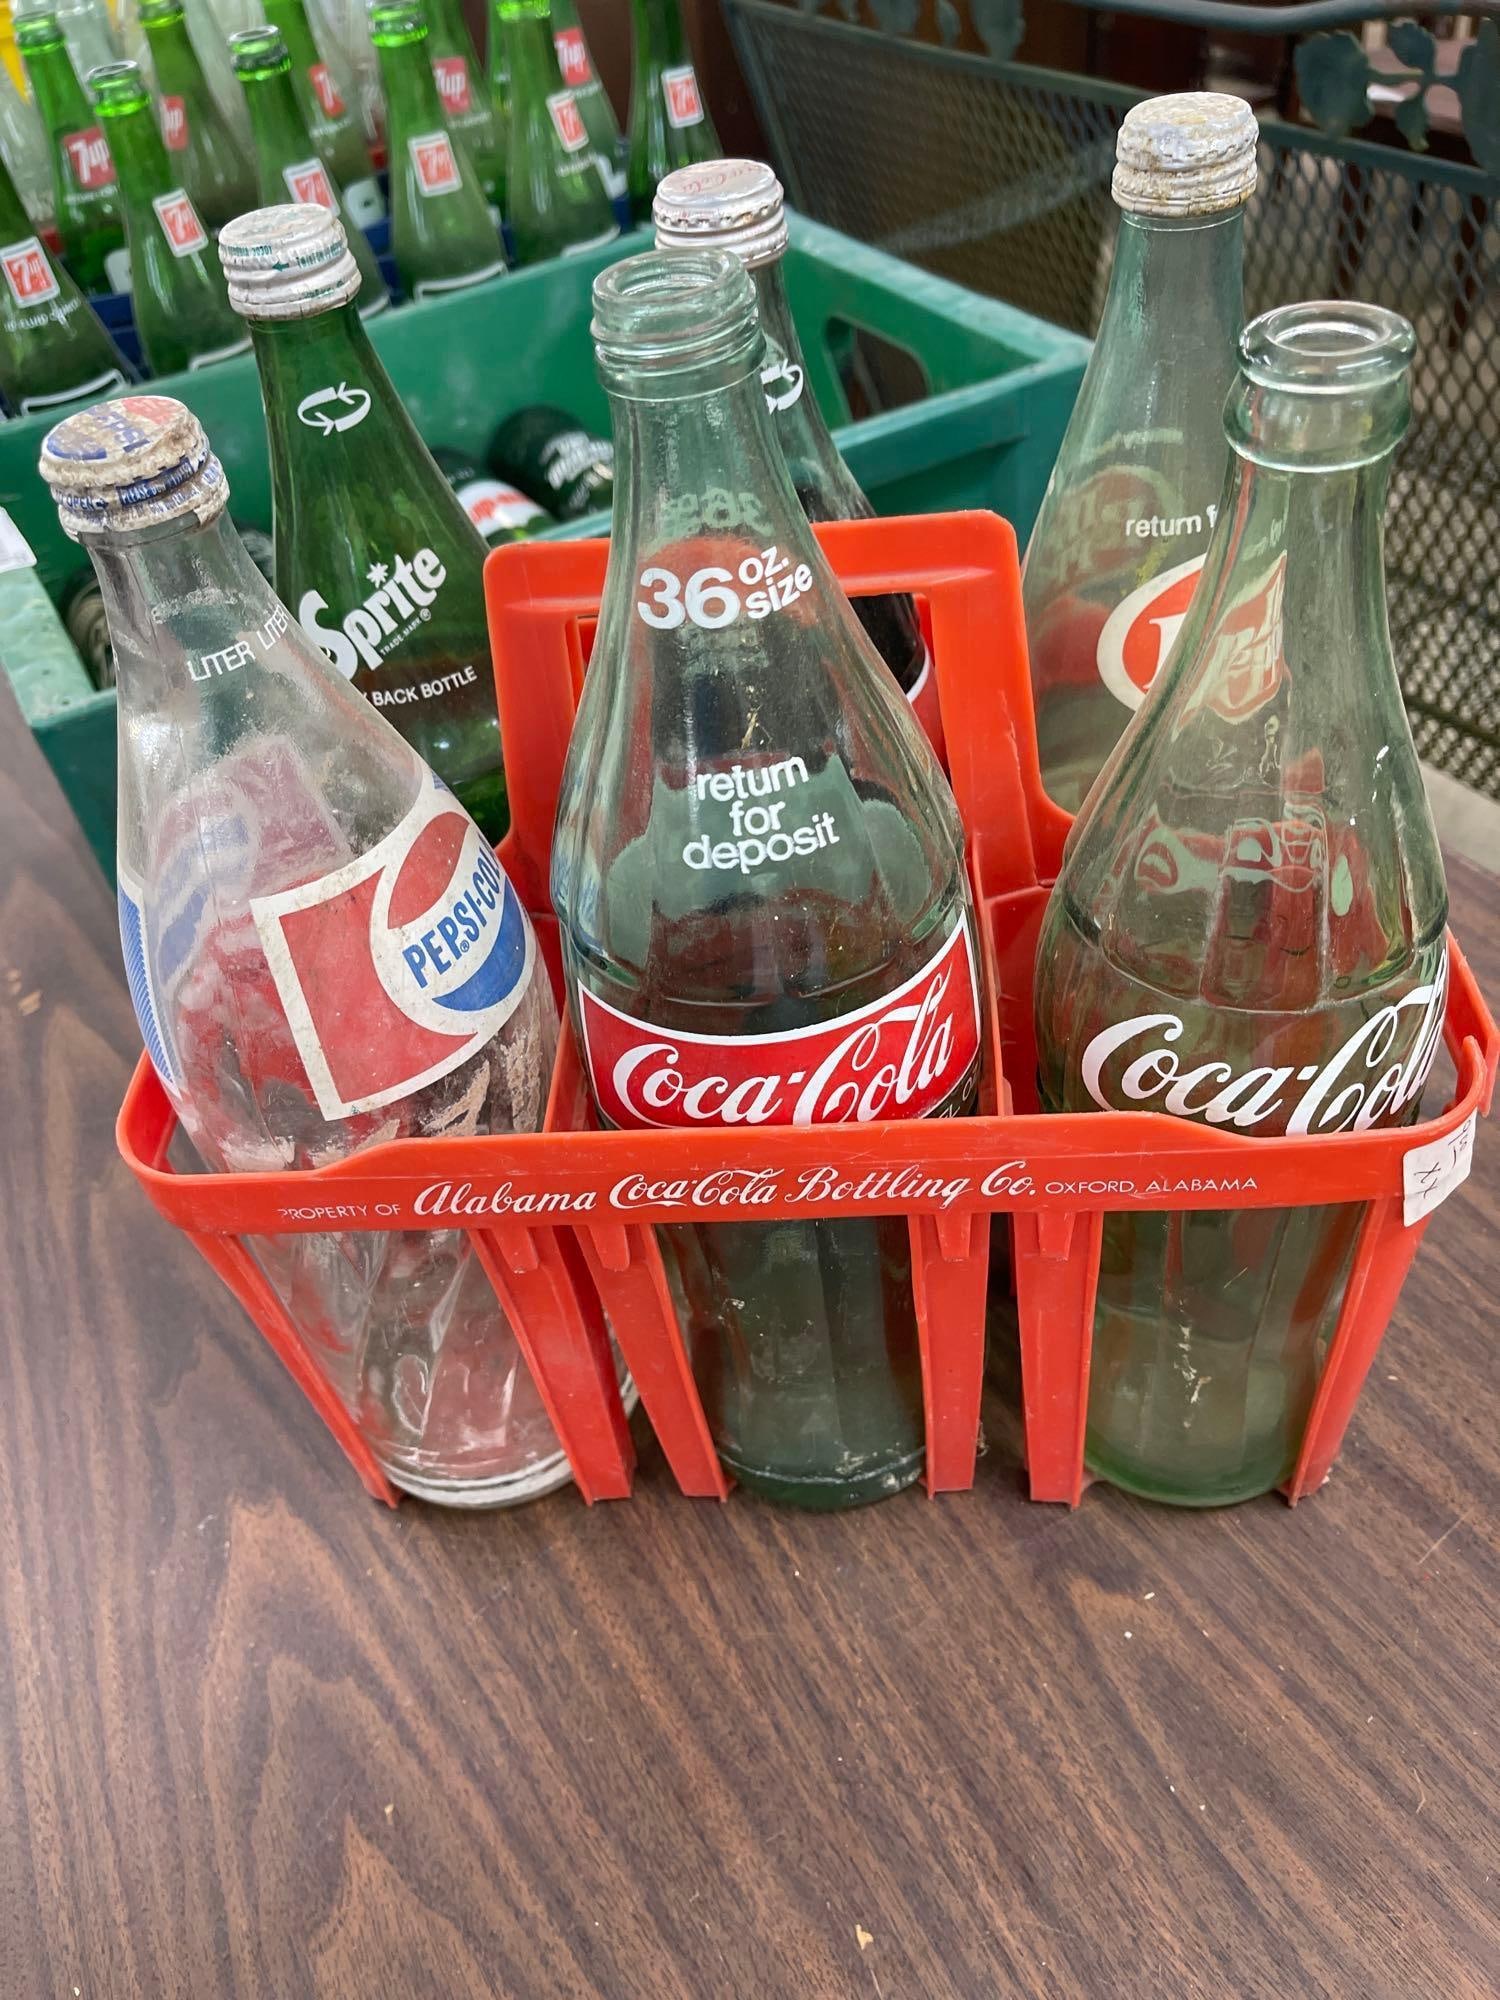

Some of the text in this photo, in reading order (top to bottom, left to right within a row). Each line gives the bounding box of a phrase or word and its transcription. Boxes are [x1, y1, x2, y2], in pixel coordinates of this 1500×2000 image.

[1125, 512, 1202, 538] return
[299, 548, 447, 681] Sprite
[637, 546, 790, 630] 36 oz.
[745, 562, 814, 620] size
[187, 640, 256, 683] LITER
[371, 665, 478, 707] BACK BOTTLE
[695, 756, 809, 802] return
[682, 811, 840, 874] deposit
[729, 801, 786, 837] for
[612, 961, 954, 1128] Coca-Cola
[374, 1203, 402, 1217] OF
[413, 1180, 598, 1217] Alabama
[608, 1167, 786, 1210] Coca-Cola
[783, 1164, 975, 1210] Bottling
[979, 1160, 1036, 1197] Co.
[1045, 1180, 1138, 1195] OXFORD,
[1144, 1177, 1259, 1193] ALABAMA
